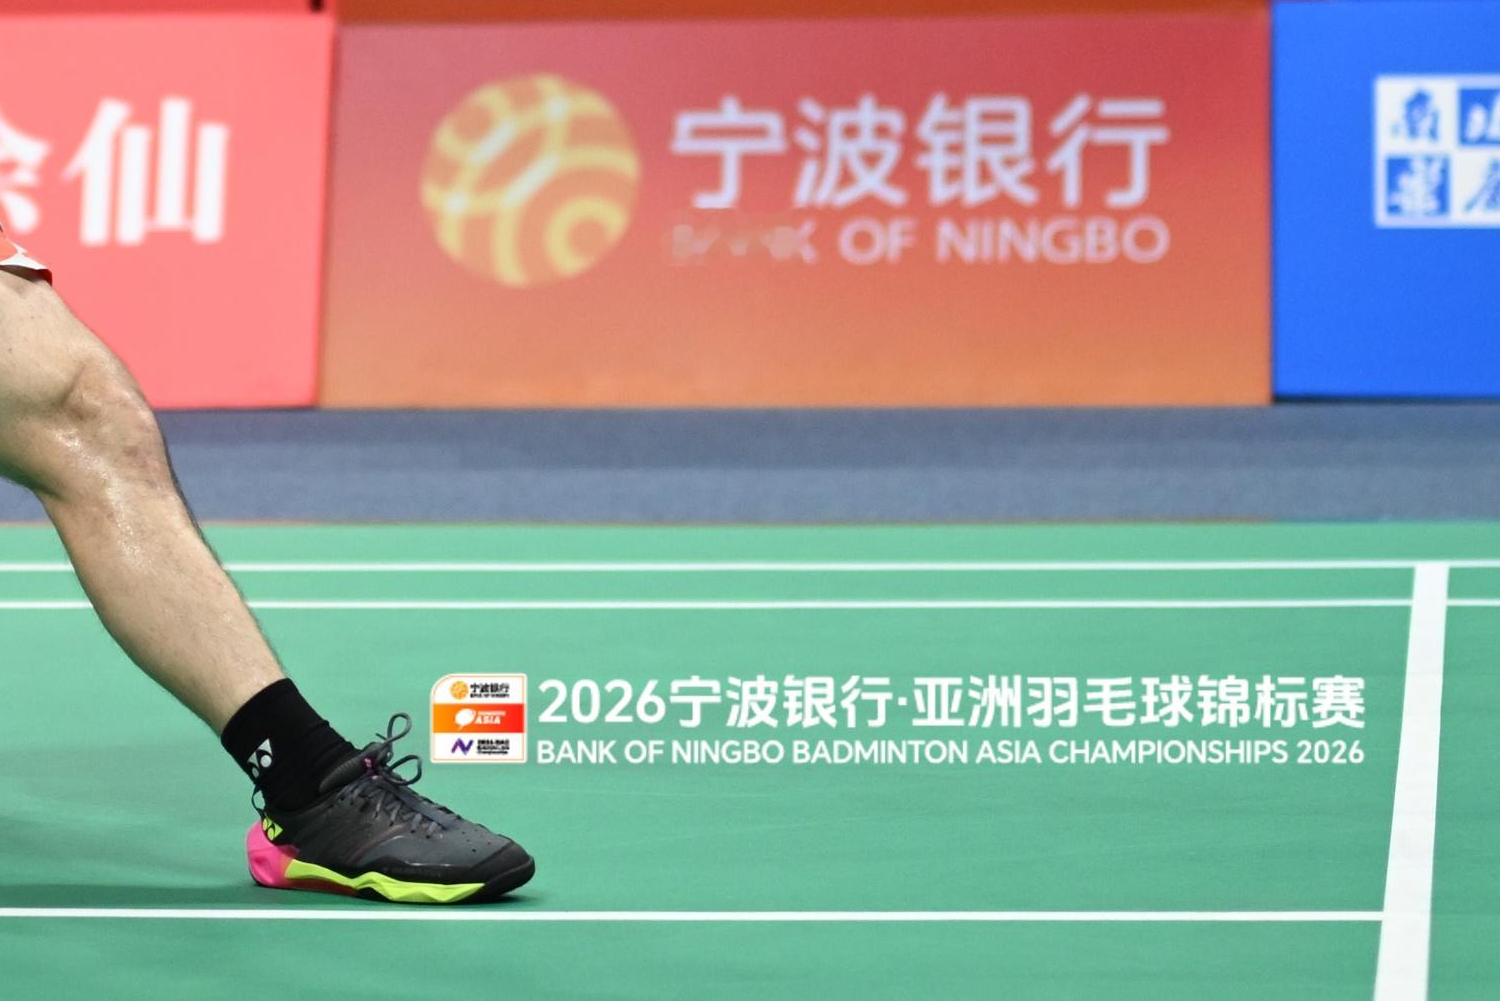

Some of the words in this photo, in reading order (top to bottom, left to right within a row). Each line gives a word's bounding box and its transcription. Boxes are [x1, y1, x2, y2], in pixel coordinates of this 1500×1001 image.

[670, 93, 1170, 209] 宁波银行
[838, 216, 916, 265] OF
[936, 216, 1170, 265] NINGBO
